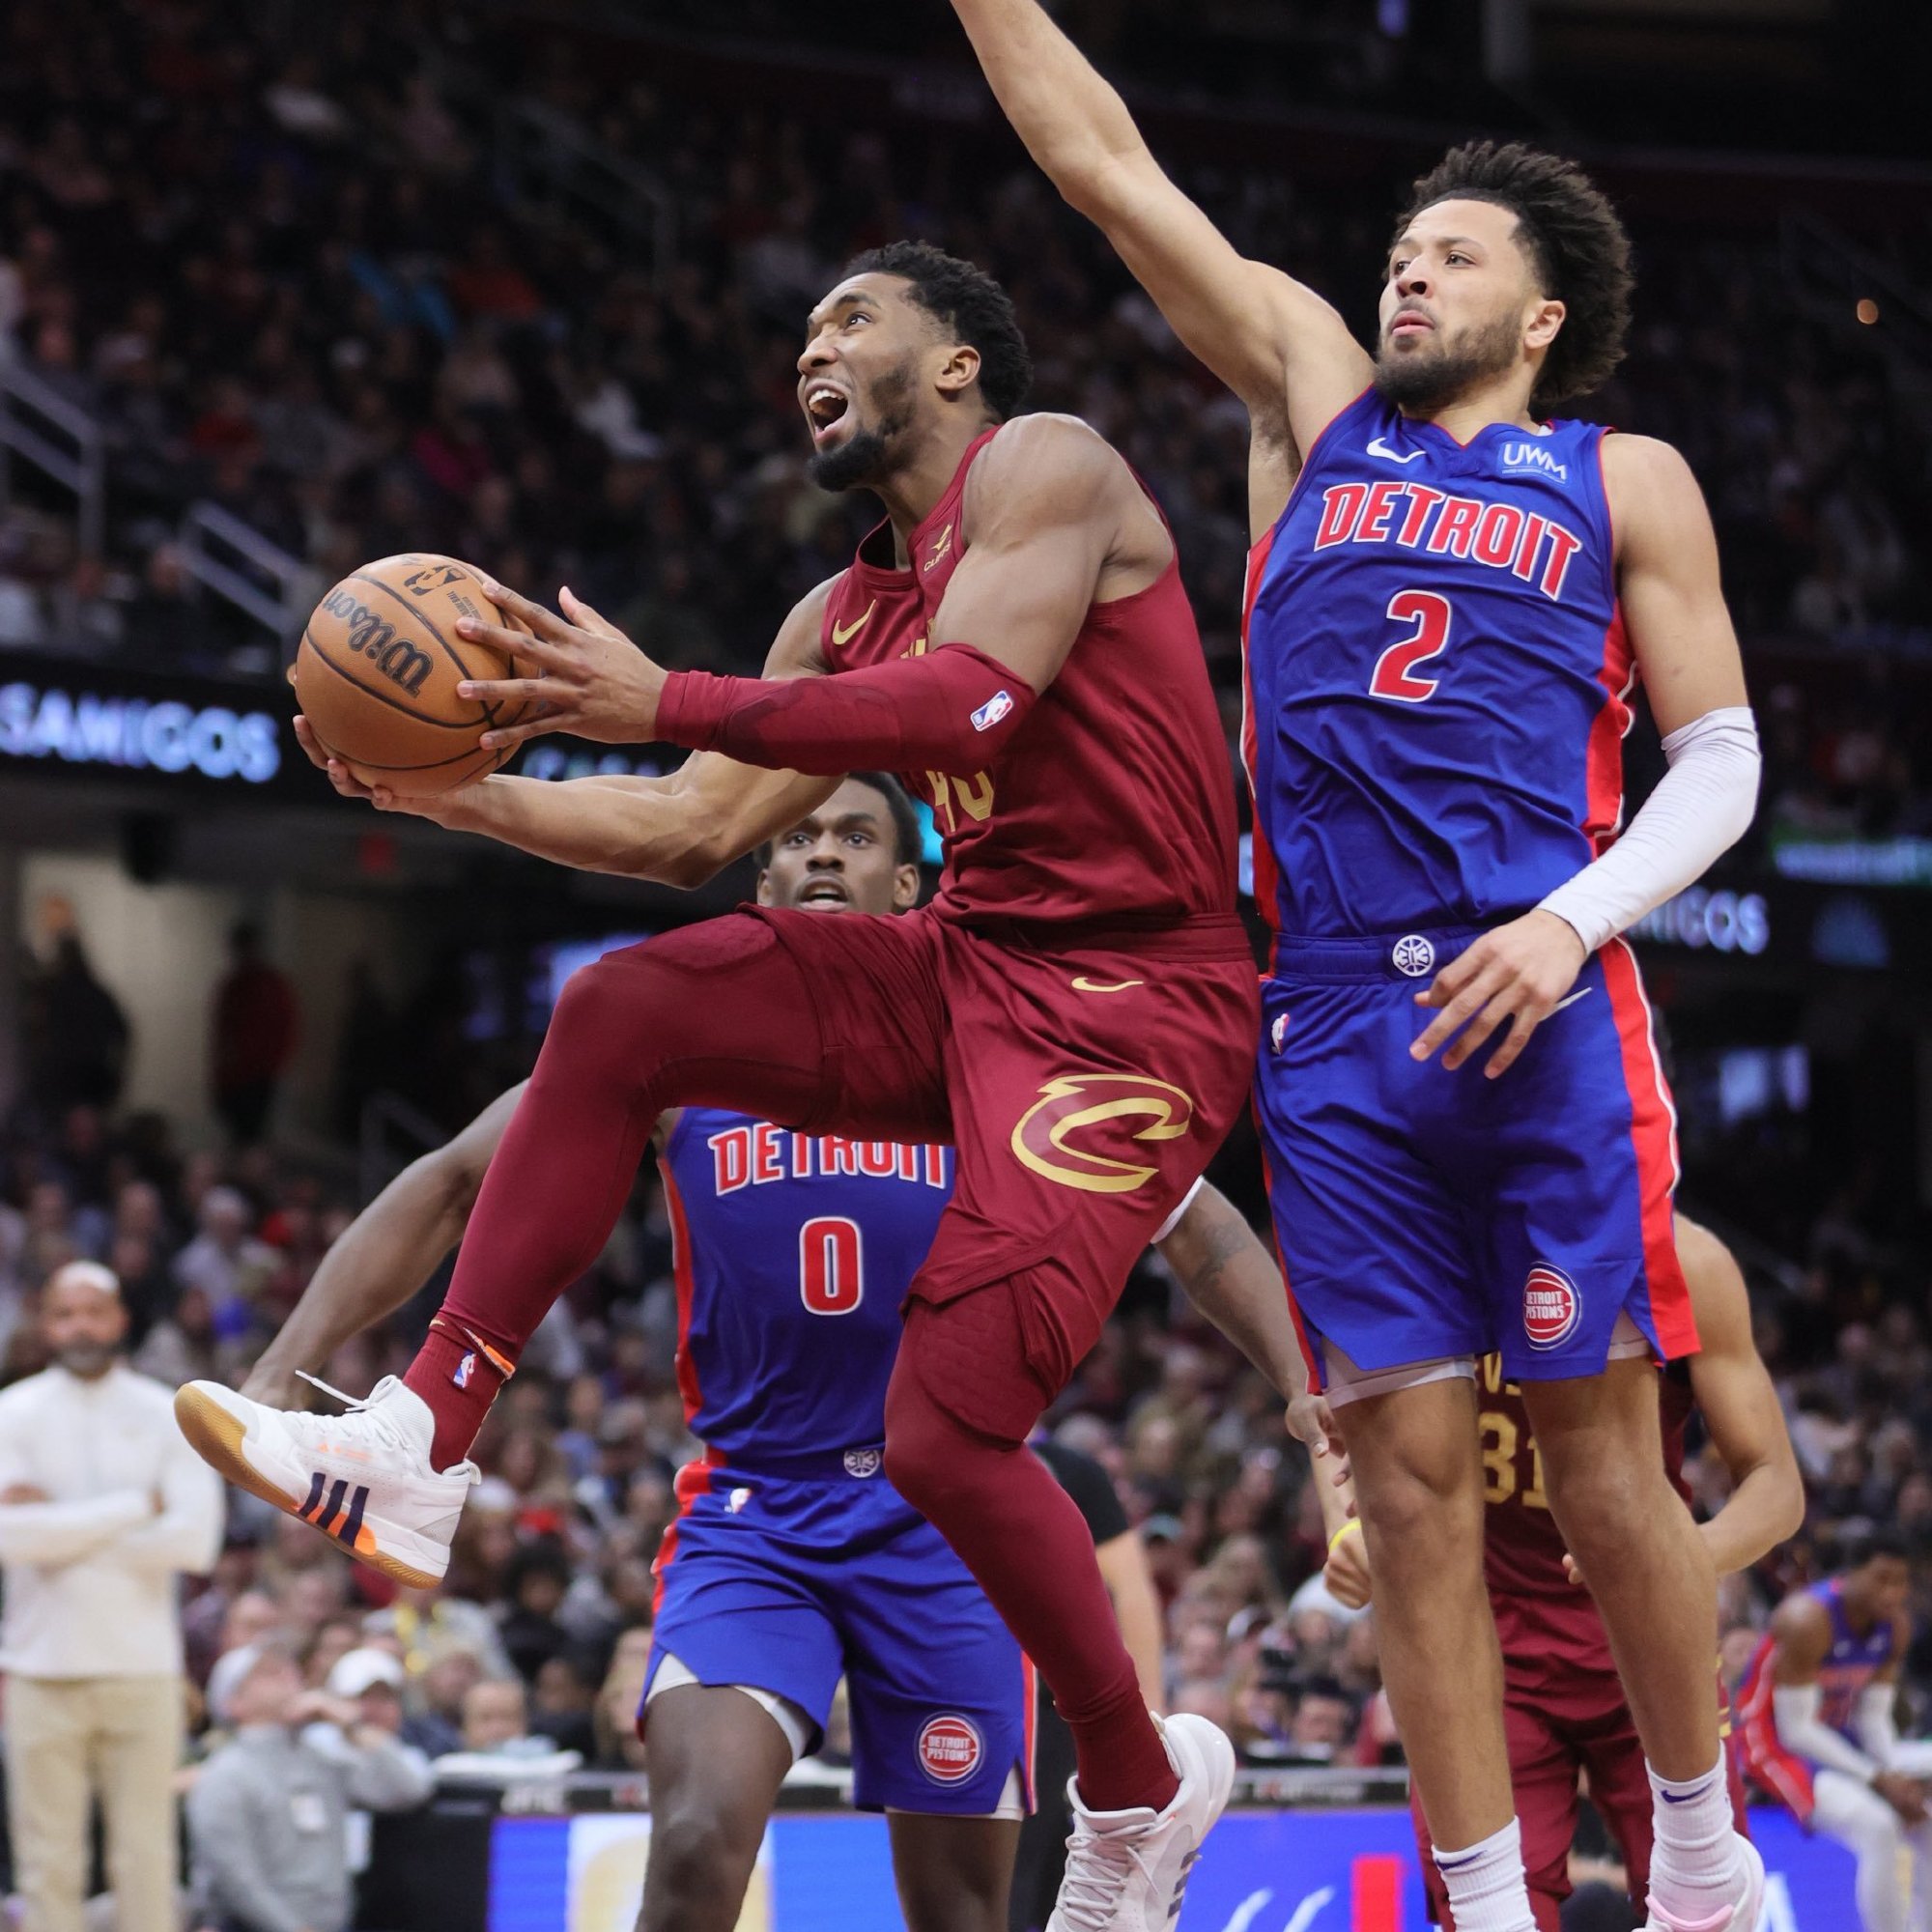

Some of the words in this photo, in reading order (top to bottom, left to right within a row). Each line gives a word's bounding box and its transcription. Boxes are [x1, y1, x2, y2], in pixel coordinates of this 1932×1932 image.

[1503, 443, 1567, 480] UWM
[1314, 482, 1582, 601] DETROIT
[323, 588, 434, 698] Wilson
[1369, 589, 1451, 703] 2
[799, 1216, 864, 1316] 0
[927, 1735, 970, 1749] DETROIT
[927, 1747, 970, 1762] PISTONS
